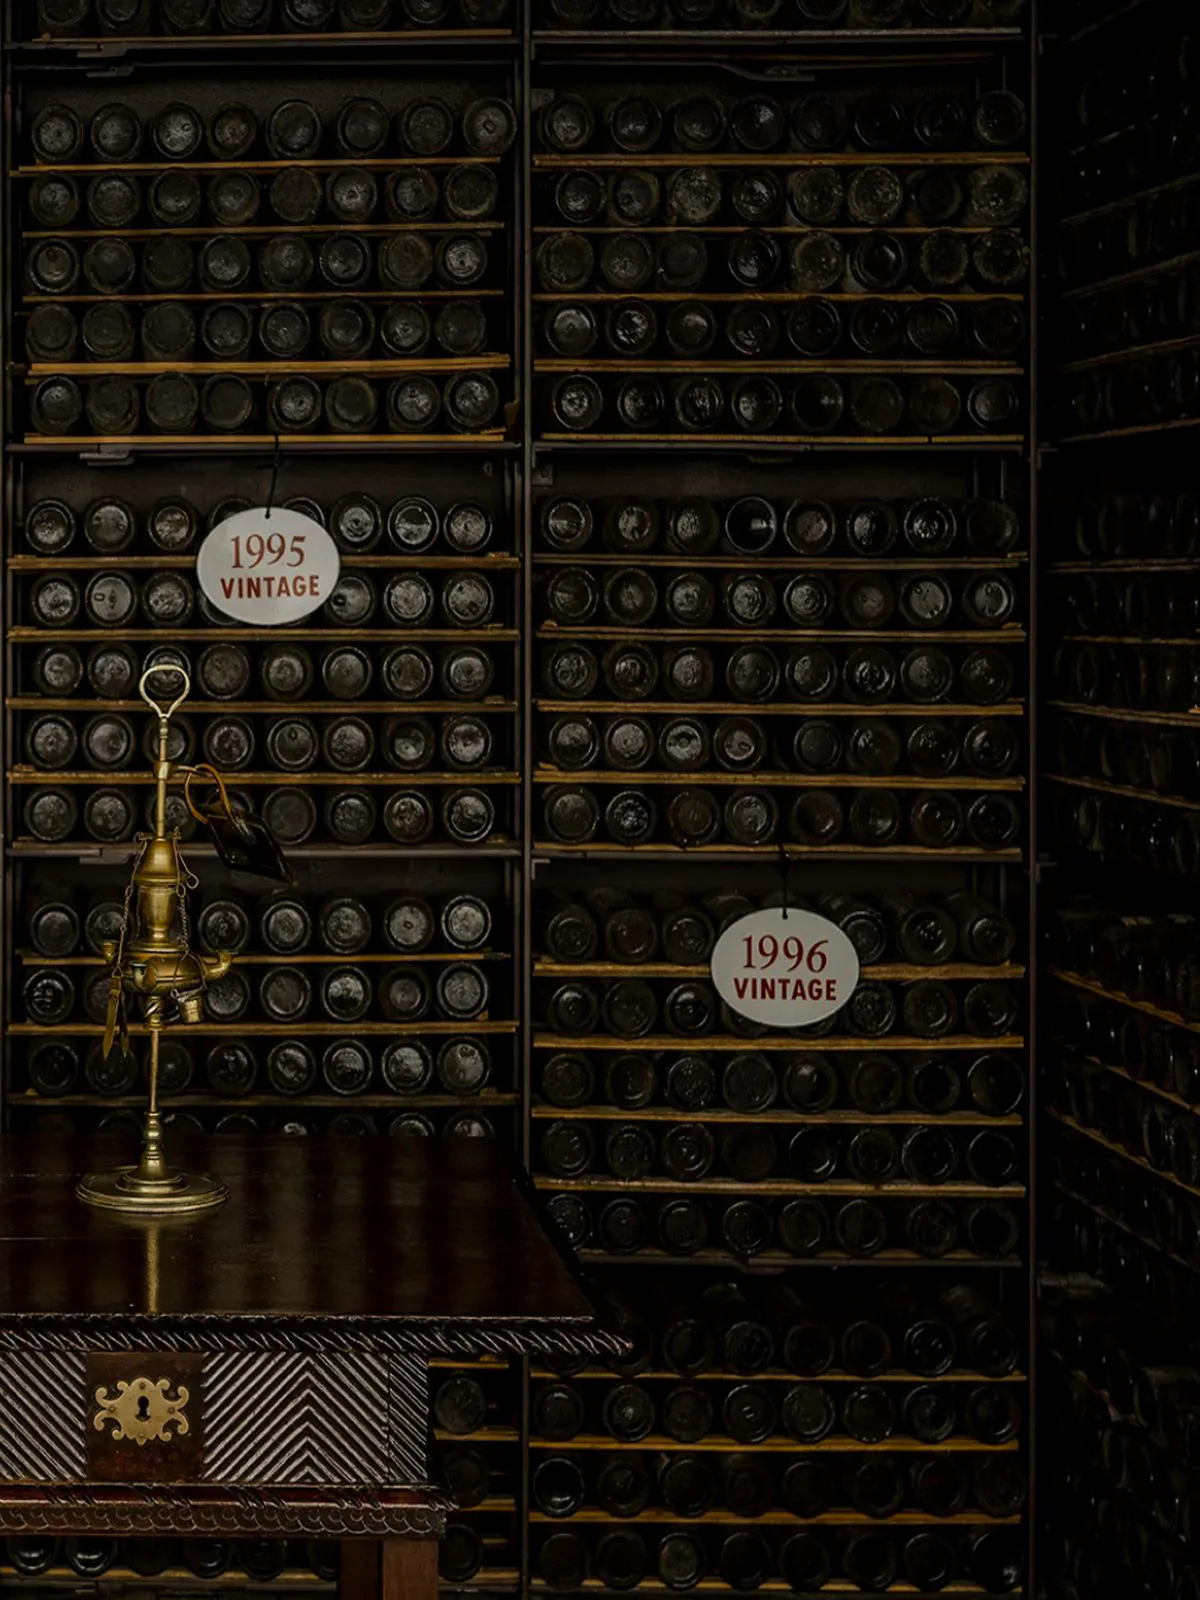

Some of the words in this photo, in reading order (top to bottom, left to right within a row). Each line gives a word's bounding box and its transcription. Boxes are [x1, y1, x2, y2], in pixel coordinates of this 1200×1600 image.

[230, 533, 306, 569] 1995
[220, 574, 320, 599] VINTAGE
[742, 934, 829, 973] 1996
[733, 977, 838, 1001] VINTAGE
